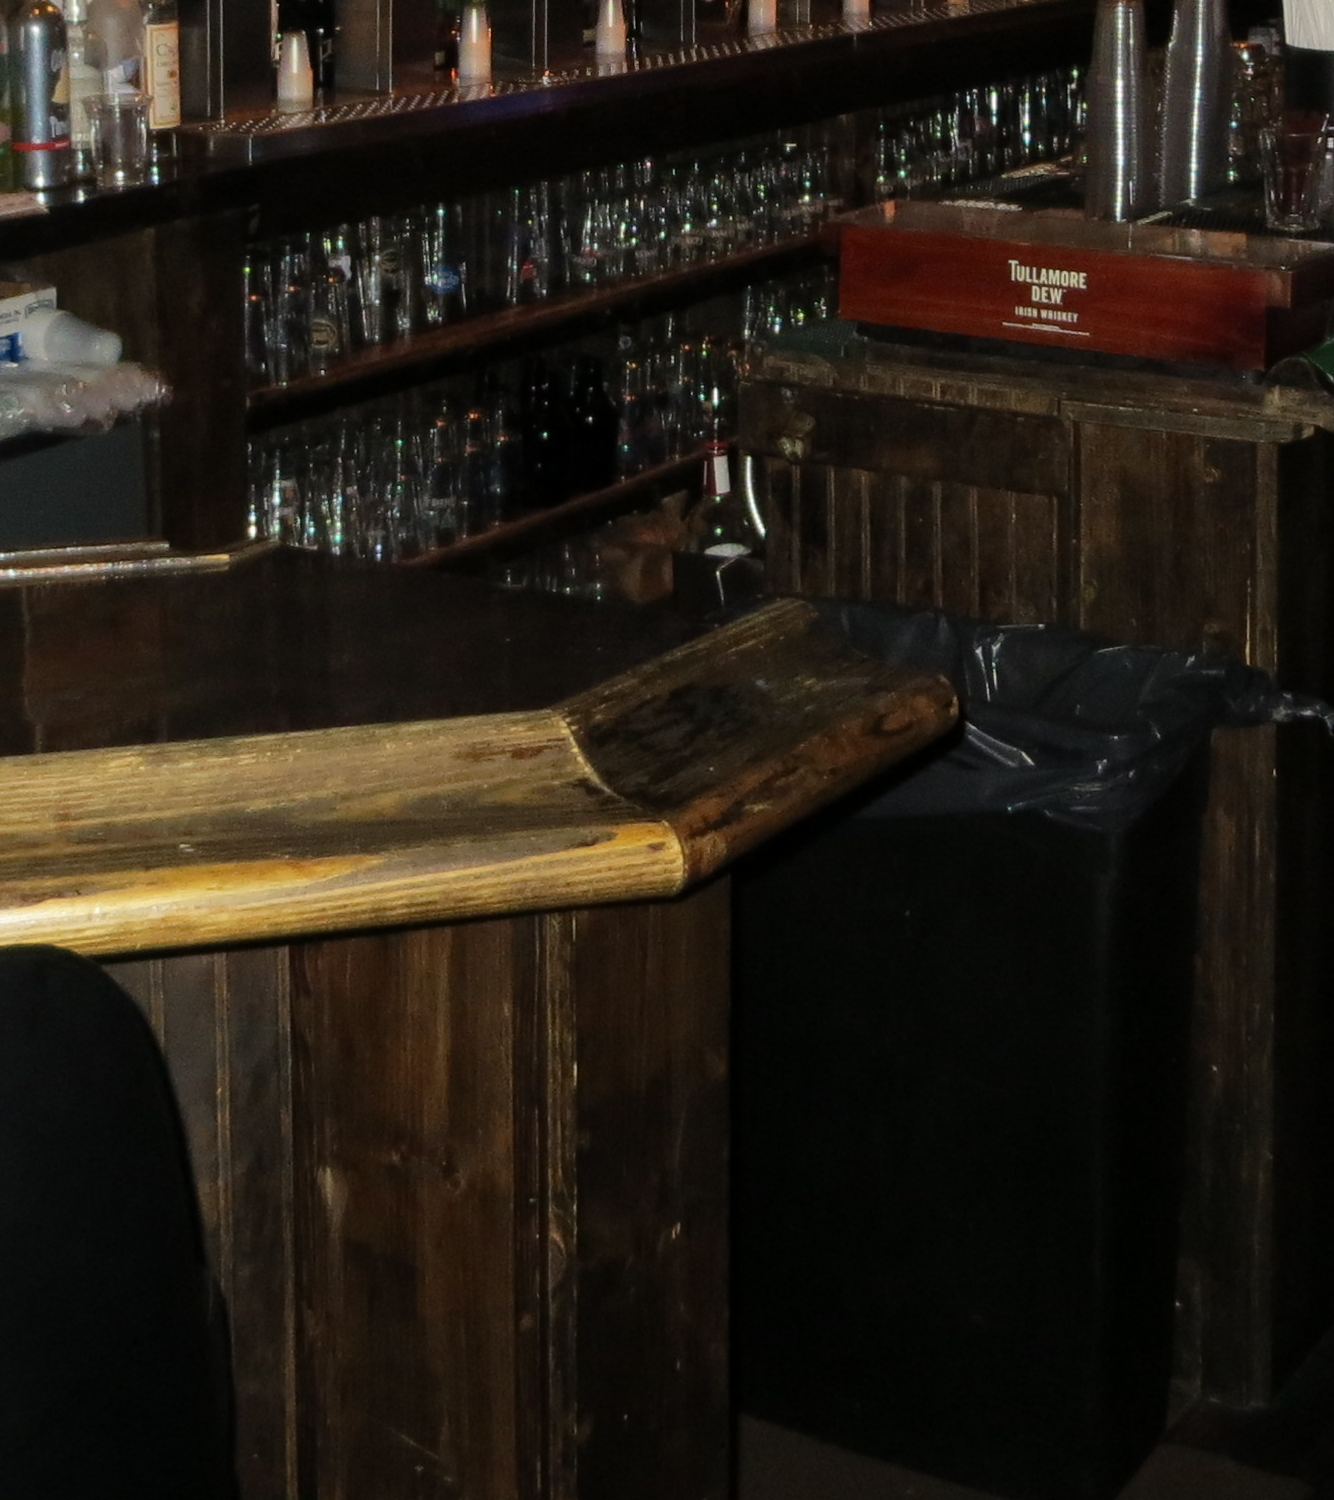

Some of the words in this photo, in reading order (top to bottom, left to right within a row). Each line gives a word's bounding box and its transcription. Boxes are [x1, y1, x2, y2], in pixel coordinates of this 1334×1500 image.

[1008, 259, 1088, 290] TULLAMORE
[1014, 305, 1039, 319] IRISH
[1040, 308, 1079, 323] WHISKEY
